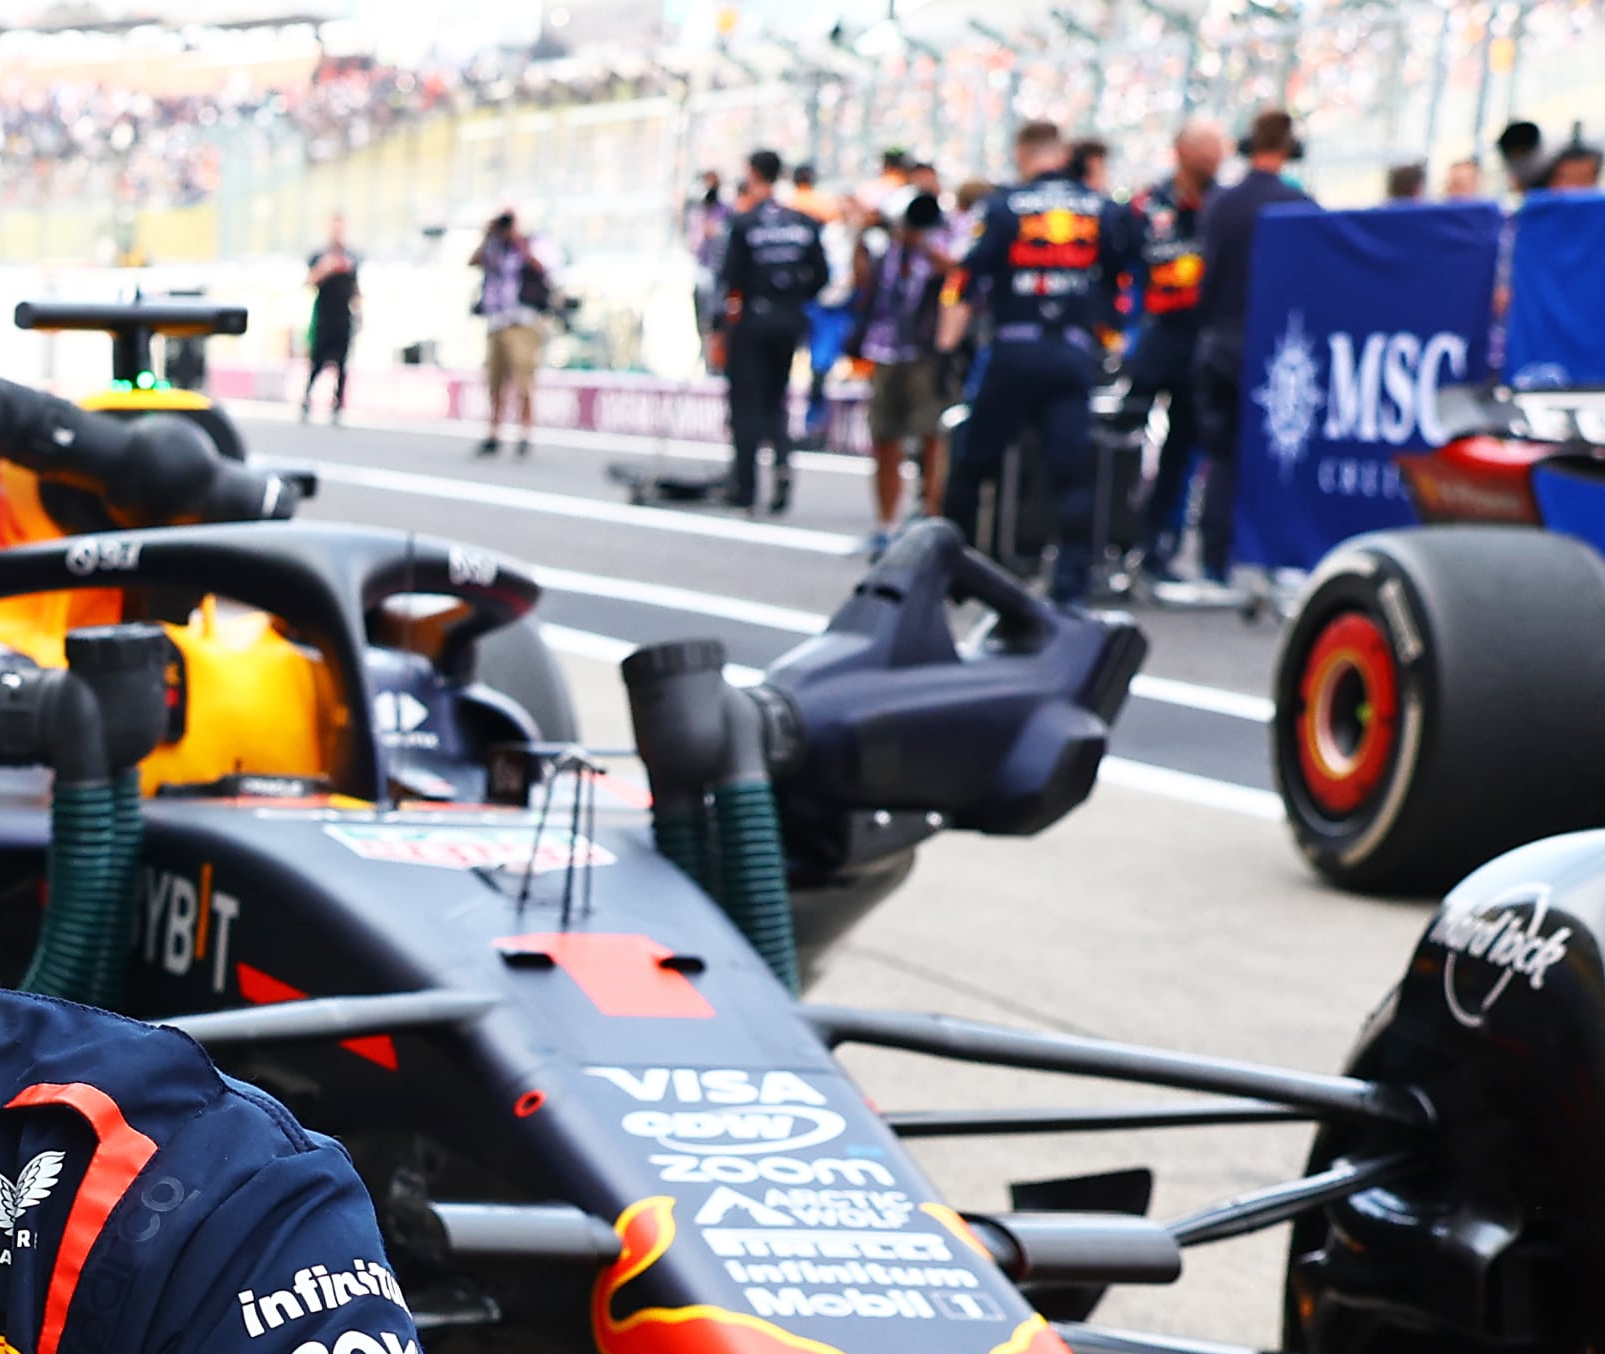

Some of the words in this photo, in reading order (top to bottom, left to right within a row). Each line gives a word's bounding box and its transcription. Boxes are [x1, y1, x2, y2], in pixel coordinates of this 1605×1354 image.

[1323, 331, 1469, 447] MSC
[135, 862, 241, 994] YBIT
[584, 1066, 828, 1106] VISA
[621, 1110, 794, 1140] CDW
[648, 1153, 897, 1187] zoom
[237, 1259, 413, 1338] infinitu
[744, 1287, 936, 1319] Mobil
